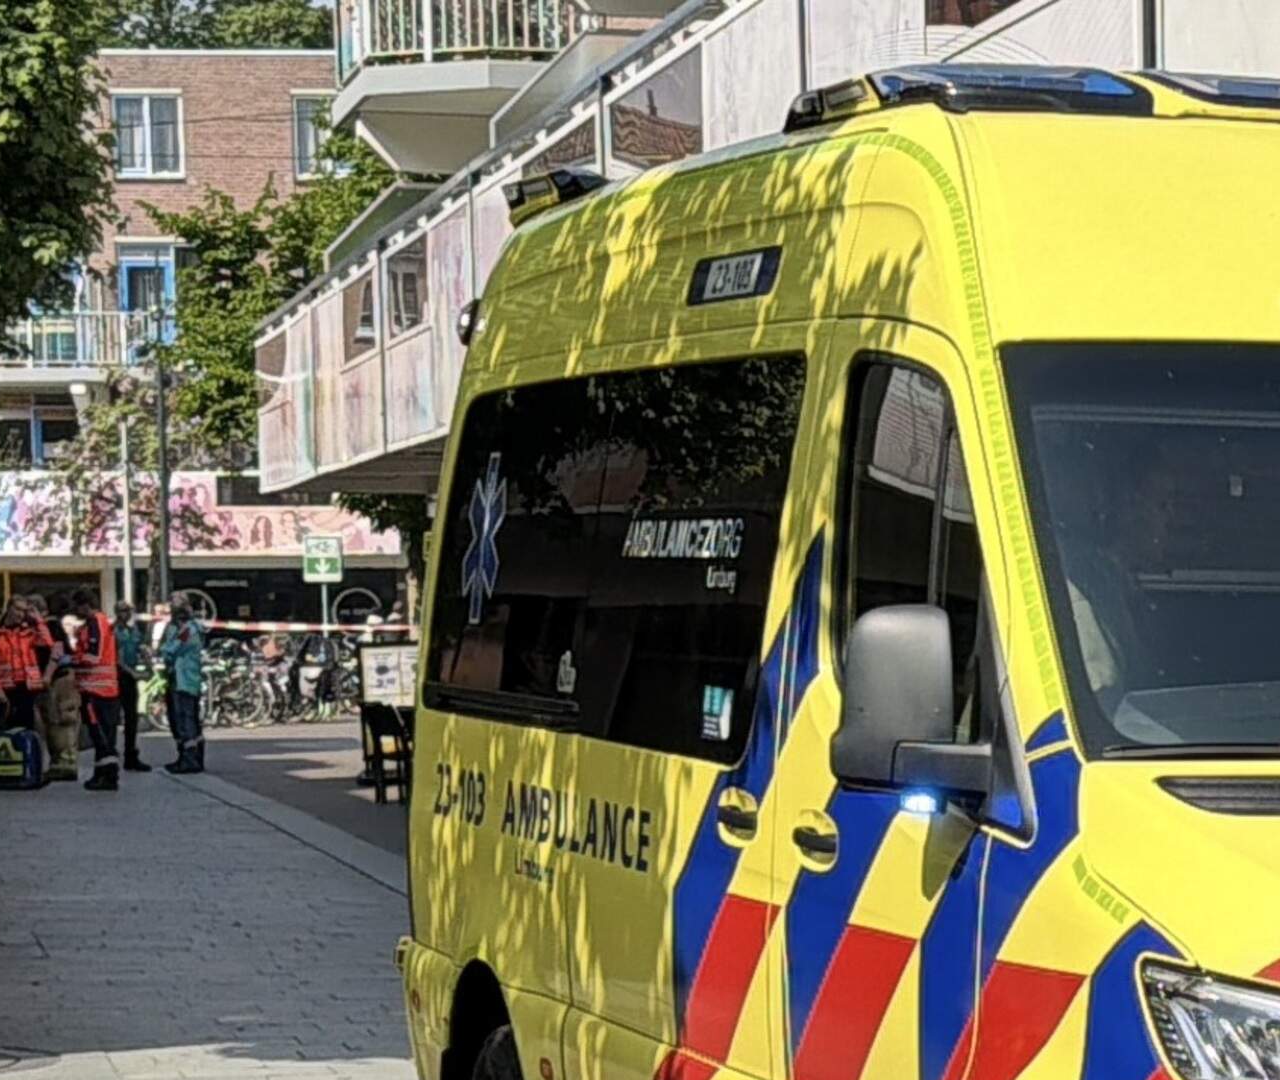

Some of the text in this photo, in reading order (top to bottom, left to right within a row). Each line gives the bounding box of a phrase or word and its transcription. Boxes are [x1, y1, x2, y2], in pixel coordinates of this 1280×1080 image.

[711, 256, 757, 294] 23-103
[434, 762, 652, 872] 23-103 AMBULANCE
